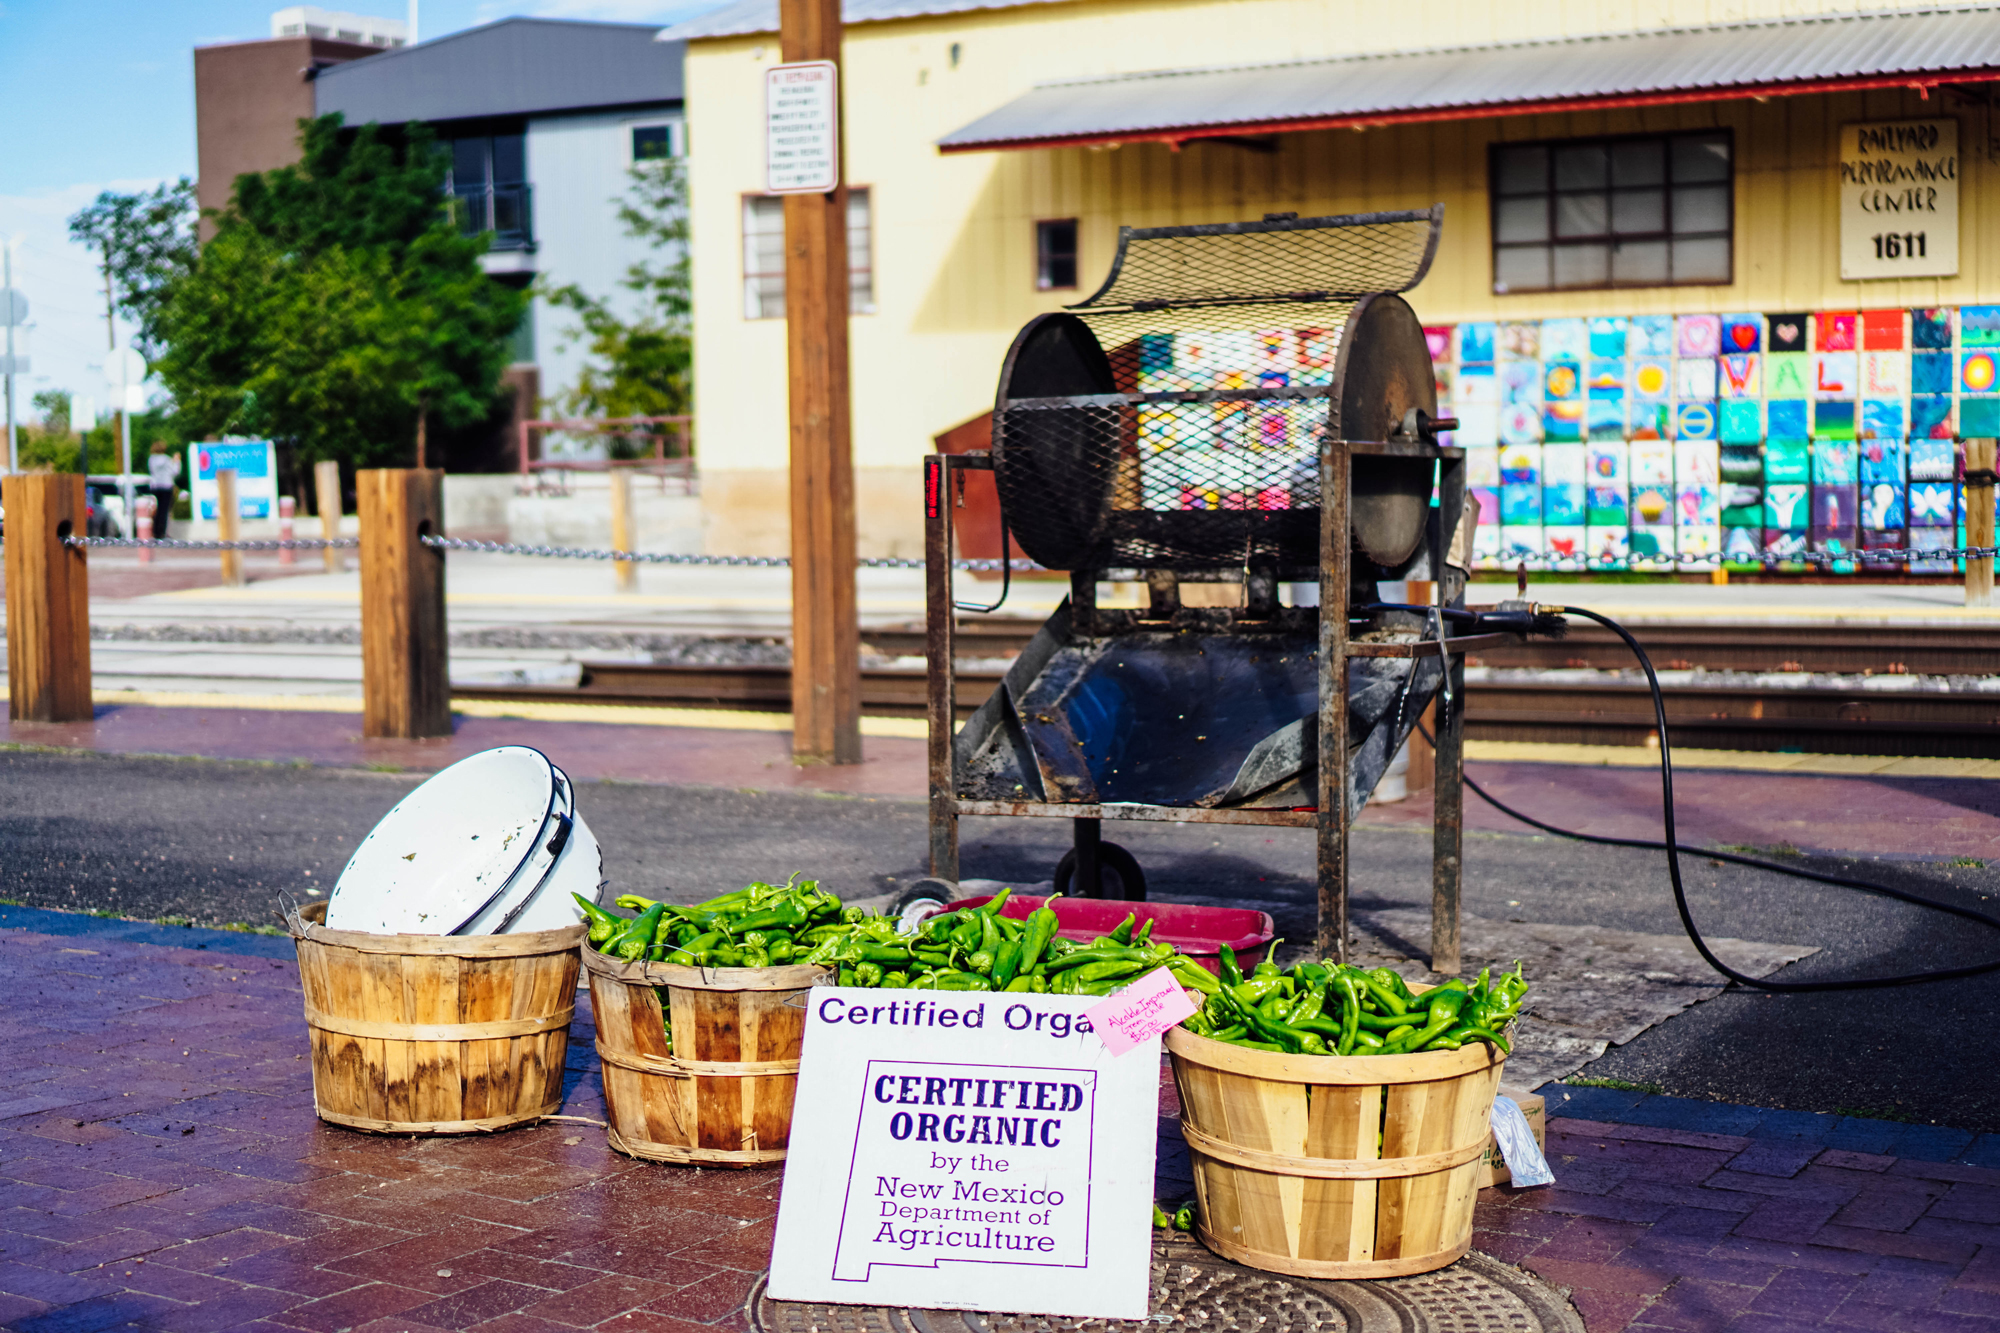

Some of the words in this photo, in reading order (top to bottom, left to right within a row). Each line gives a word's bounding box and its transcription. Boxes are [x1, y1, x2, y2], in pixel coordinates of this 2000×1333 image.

[1857, 123, 1939, 155] RAILYARD
[1841, 156, 1956, 186] PERFORMANCE
[1860, 186, 1938, 213] CENTER
[1871, 230, 1926, 259] 1611
[818, 997, 985, 1029] Certified
[1003, 1003, 1095, 1038] Orga
[1121, 1018, 1146, 1035] Green
[1144, 1002, 1165, 1019] Chile
[874, 1074, 1084, 1112] CERTIFIED
[889, 1111, 1062, 1148] ORGANIC
[930, 1151, 963, 1175] by
[970, 1153, 1010, 1173] the
[874, 1175, 944, 1199] New
[952, 1180, 1065, 1206] Mexico
[879, 1200, 1021, 1224] Department
[1028, 1209, 1052, 1226] of
[872, 1221, 1055, 1252] Agriculture
